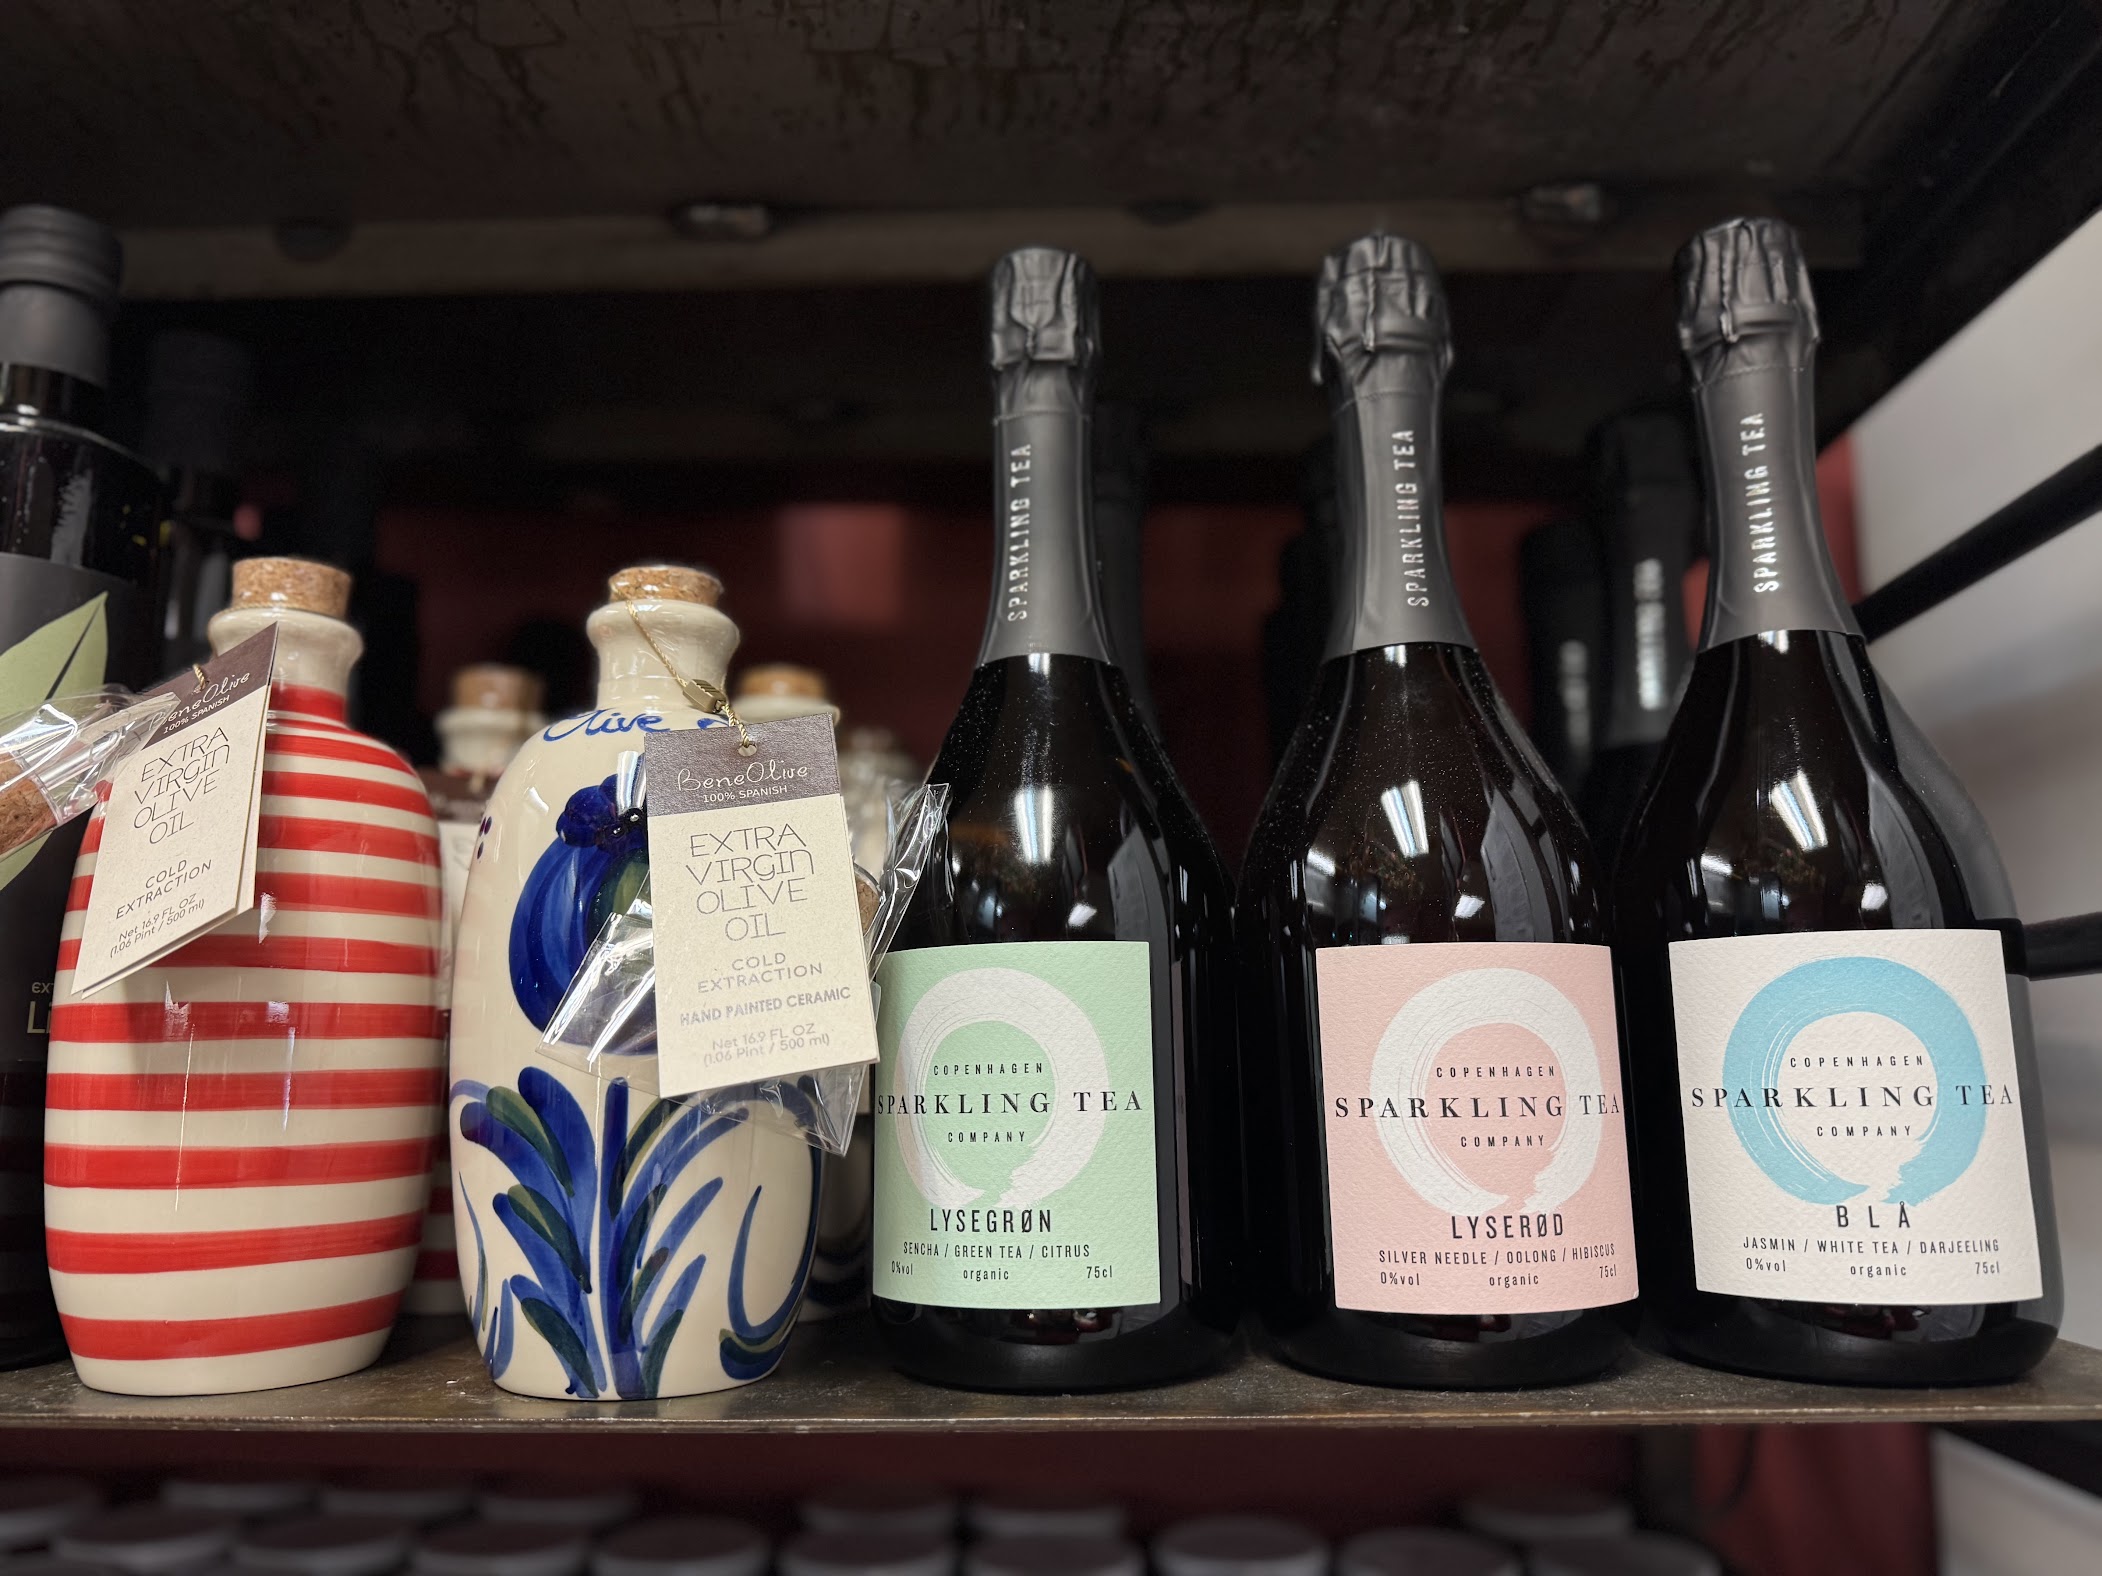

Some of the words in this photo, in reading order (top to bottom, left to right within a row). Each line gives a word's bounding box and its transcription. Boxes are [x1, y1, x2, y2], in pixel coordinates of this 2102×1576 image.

[1740, 413, 1767, 457] TEA
[1391, 430, 1416, 471] TEA
[1010, 444, 1032, 489] TEA
[1744, 465, 1780, 593] SPARKLING
[1395, 483, 1430, 607] SPARKLING
[1007, 498, 1031, 622] SPARKLING
[163, 717, 190, 735] 100%
[191, 694, 231, 721] SPANISH
[141, 726, 229, 783] EXTRA
[677, 759, 809, 791] BeneOlive
[133, 768, 220, 829] OLIVE
[703, 791, 736, 804] 100%
[739, 784, 788, 799] SPANISH
[149, 810, 195, 845] OIL
[690, 823, 807, 858] EXTRA
[145, 859, 188, 889] COLD
[115, 859, 212, 920] EXTRACTION
[696, 877, 808, 915] OLIVE
[110, 940, 132, 959] (1.06
[134, 926, 156, 943] Pint
[157, 921, 165, 932] /
[166, 908, 186, 926] 500
[188, 898, 205, 915] ml)
[118, 925, 139, 942] Net
[142, 913, 160, 930] 16.9
[161, 906, 176, 920] FL
[179, 892, 197, 909] OZ
[724, 912, 787, 942] OIL
[731, 952, 786, 972] COLD
[697, 962, 823, 994] EXTRACTION
[679, 1008, 722, 1027] HAND
[726, 1000, 783, 1019] PAINTED
[786, 986, 852, 1008] CERAMIC
[712, 1039, 738, 1051] Net
[743, 1031, 767, 1046] 16.9
[770, 1028, 788, 1041] FL
[792, 1023, 817, 1037] OZ
[736, 1044, 764, 1059] Pint
[780, 1037, 805, 1051] 500
[933, 1062, 1044, 1076] COPENHAGEN
[1436, 1066, 1556, 1078] COPENHAGEN
[1790, 1055, 1924, 1068] COPENHAGEN
[878, 1092, 1050, 1115] SPARKLING
[1073, 1090, 1143, 1112] TEA
[1334, 1095, 1563, 1119] SPARKLING
[1579, 1093, 1620, 1116] TEA
[1691, 1086, 1935, 1109] SPARKLING
[1955, 1084, 2014, 1106] TEA
[947, 1131, 1027, 1143] COMPANY
[1460, 1134, 1546, 1148] COMPANY
[1816, 1125, 1911, 1137] COMPANY
[930, 1208, 1052, 1233] LYSEGRØN
[1451, 1213, 1565, 1240] LYSERØD
[903, 1241, 940, 1257] SENCHA
[944, 1243, 950, 1258] /
[954, 1244, 993, 1258] GREEN
[1000, 1245, 1023, 1259] TEA
[1029, 1244, 1035, 1260] /
[1041, 1244, 1090, 1258] CITRUS
[1379, 1250, 1428, 1264] SILVER
[1434, 1251, 1487, 1266] NEEDLE
[1494, 1250, 1500, 1266] /
[1506, 1249, 1557, 1264] OOLONG
[1562, 1248, 1567, 1263] /
[1572, 1243, 1616, 1260] HIBISCUS
[1743, 1237, 1796, 1252] JASMIN
[1803, 1238, 1809, 1252] /
[1817, 1240, 1865, 1254] WHITE
[1872, 1241, 1899, 1255] TEA
[1906, 1240, 1912, 1254] /
[1920, 1238, 2000, 1255] DARJEELING
[891, 1260, 914, 1276] 0%vol
[962, 1267, 1010, 1282] organic
[1086, 1265, 1113, 1279] 75cl
[1380, 1271, 1420, 1286] 0%vol
[1489, 1273, 1540, 1289] organic
[1599, 1264, 1617, 1279] 75cl
[1745, 1257, 1787, 1273] 0%vol
[1850, 1263, 1907, 1279] organic
[1974, 1261, 2000, 1275] 75cl
